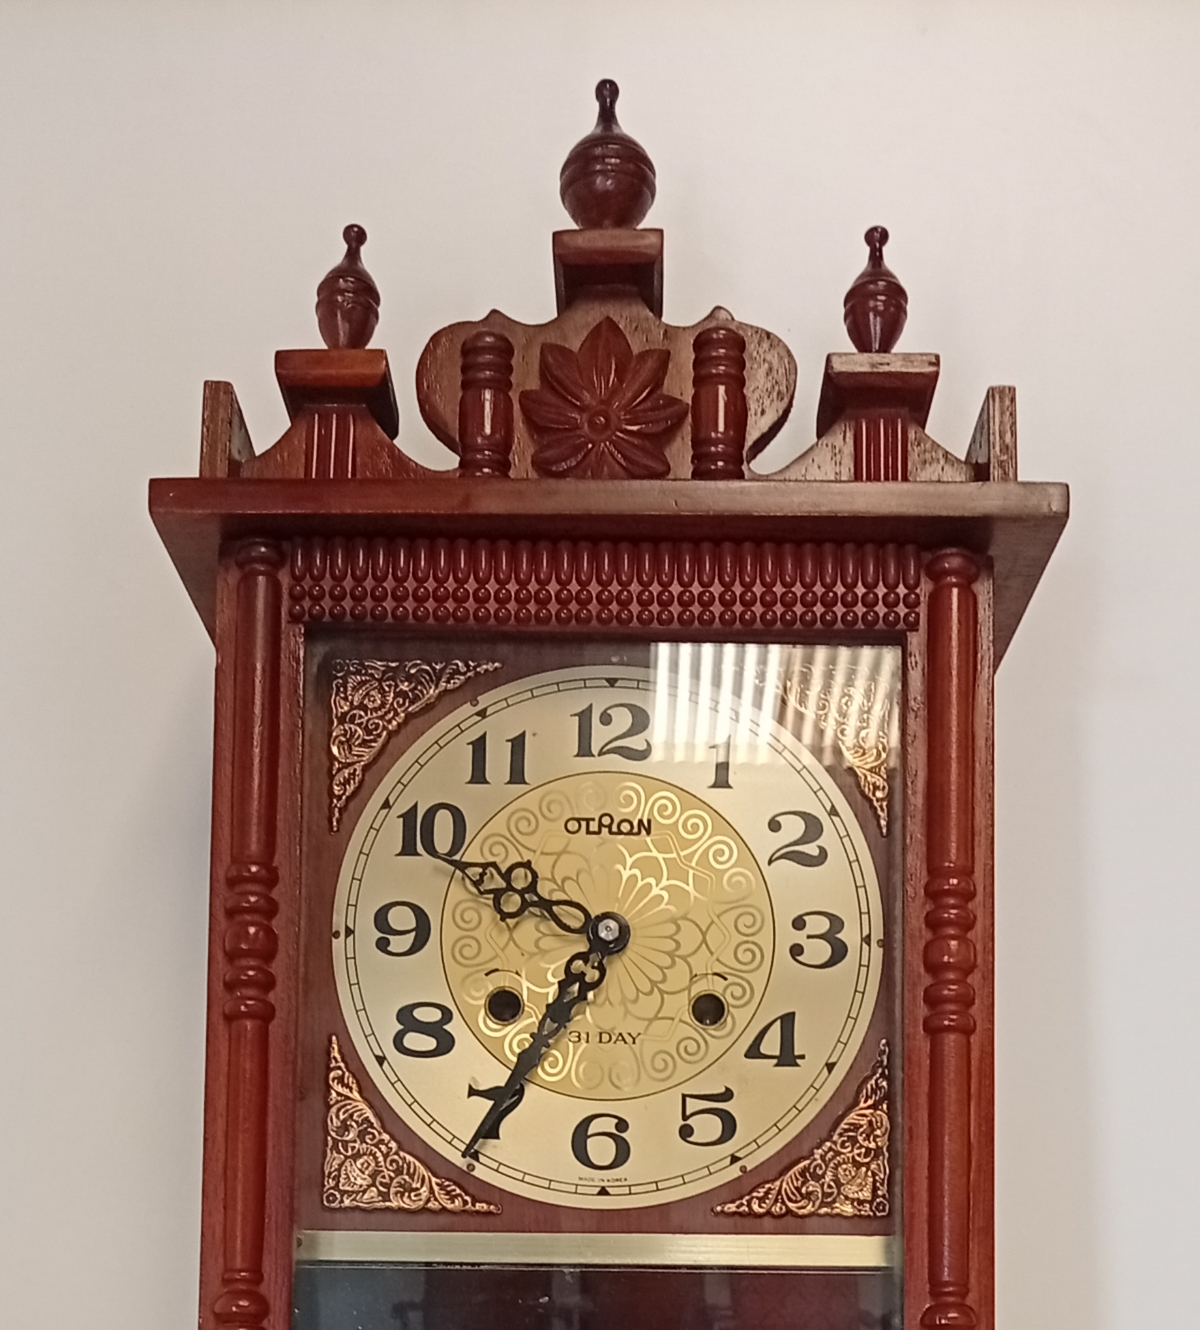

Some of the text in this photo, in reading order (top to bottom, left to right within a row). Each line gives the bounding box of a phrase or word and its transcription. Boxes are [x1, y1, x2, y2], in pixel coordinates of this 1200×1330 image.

[465, 731, 531, 785] 11
[570, 702, 652, 761] 12
[707, 733, 734, 789] 1
[395, 801, 467, 857] 10
[767, 811, 828, 867] 2
[373, 901, 431, 957] 9
[789, 911, 848, 969] 3
[392, 1002, 456, 1058] 8
[567, 1030, 642, 1045] 31 DAY
[743, 1011, 806, 1068] 4
[467, 1081, 525, 1140] 7
[678, 1086, 737, 1148] 5
[571, 1114, 631, 1170] 6
